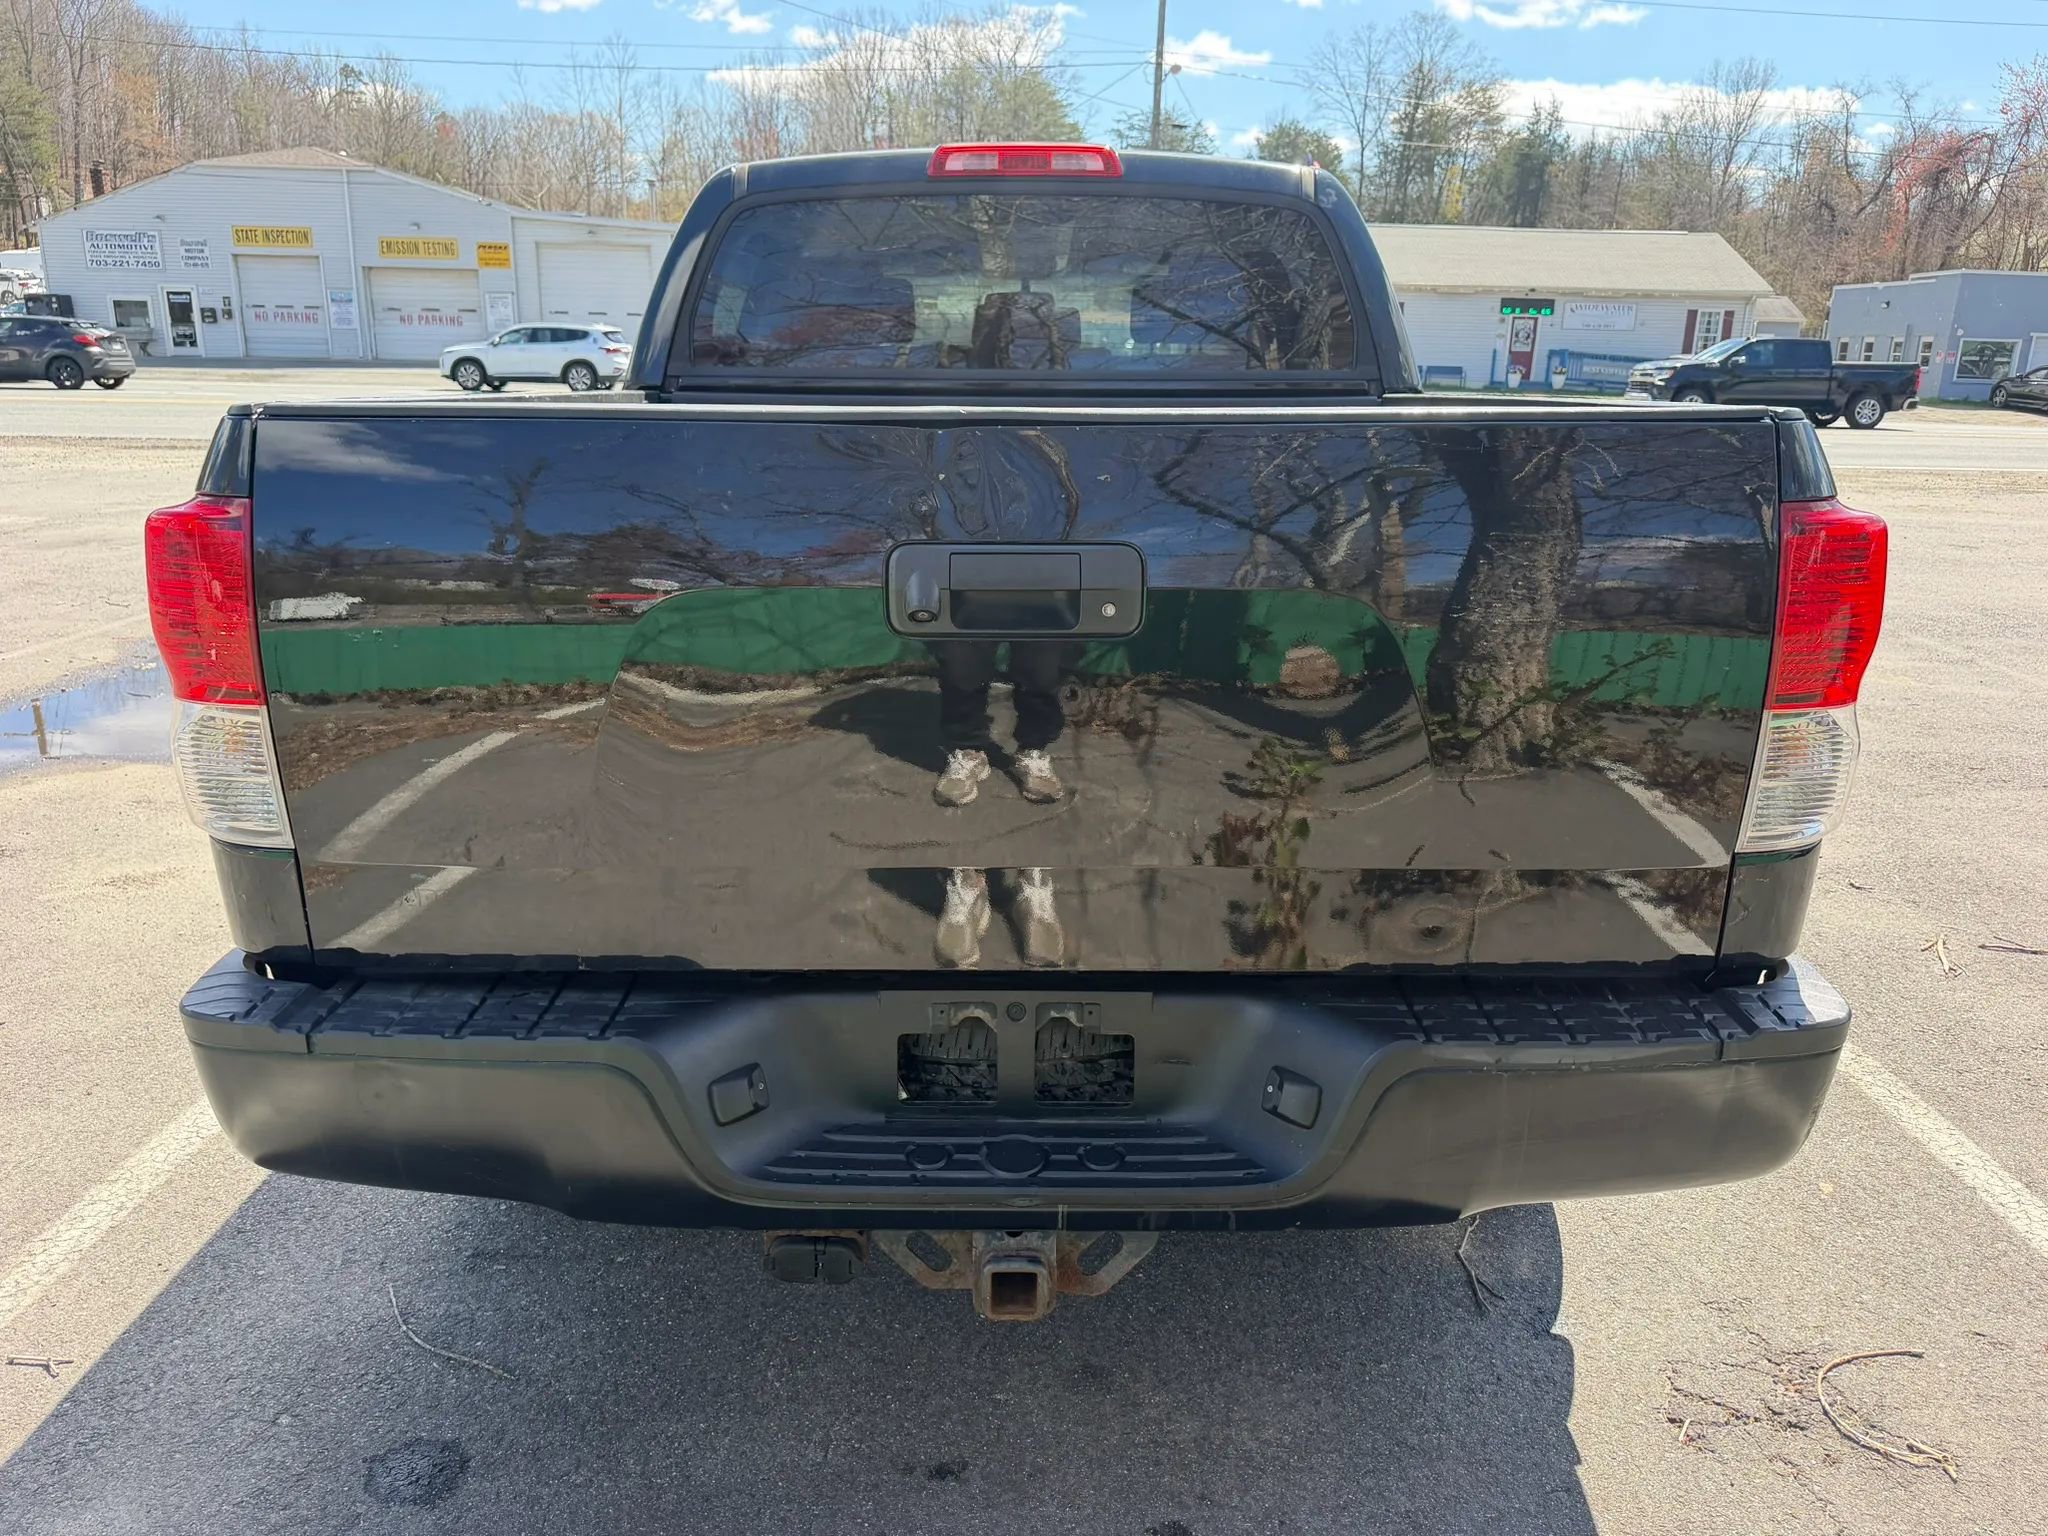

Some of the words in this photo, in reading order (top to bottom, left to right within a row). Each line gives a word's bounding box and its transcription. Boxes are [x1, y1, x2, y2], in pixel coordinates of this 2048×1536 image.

[234, 229, 259, 243] STATE
[261, 229, 310, 244] INSPECTION
[89, 243, 155, 251] AUTOMOTIVE
[380, 239, 420, 255] EMISSION
[422, 241, 456, 256] TESTING
[88, 259, 161, 268] 703-221-7450
[254, 311, 269, 322] NO
[273, 311, 319, 324] PARKING
[400, 314, 414, 325] NO
[417, 315, 464, 327] PARKING
